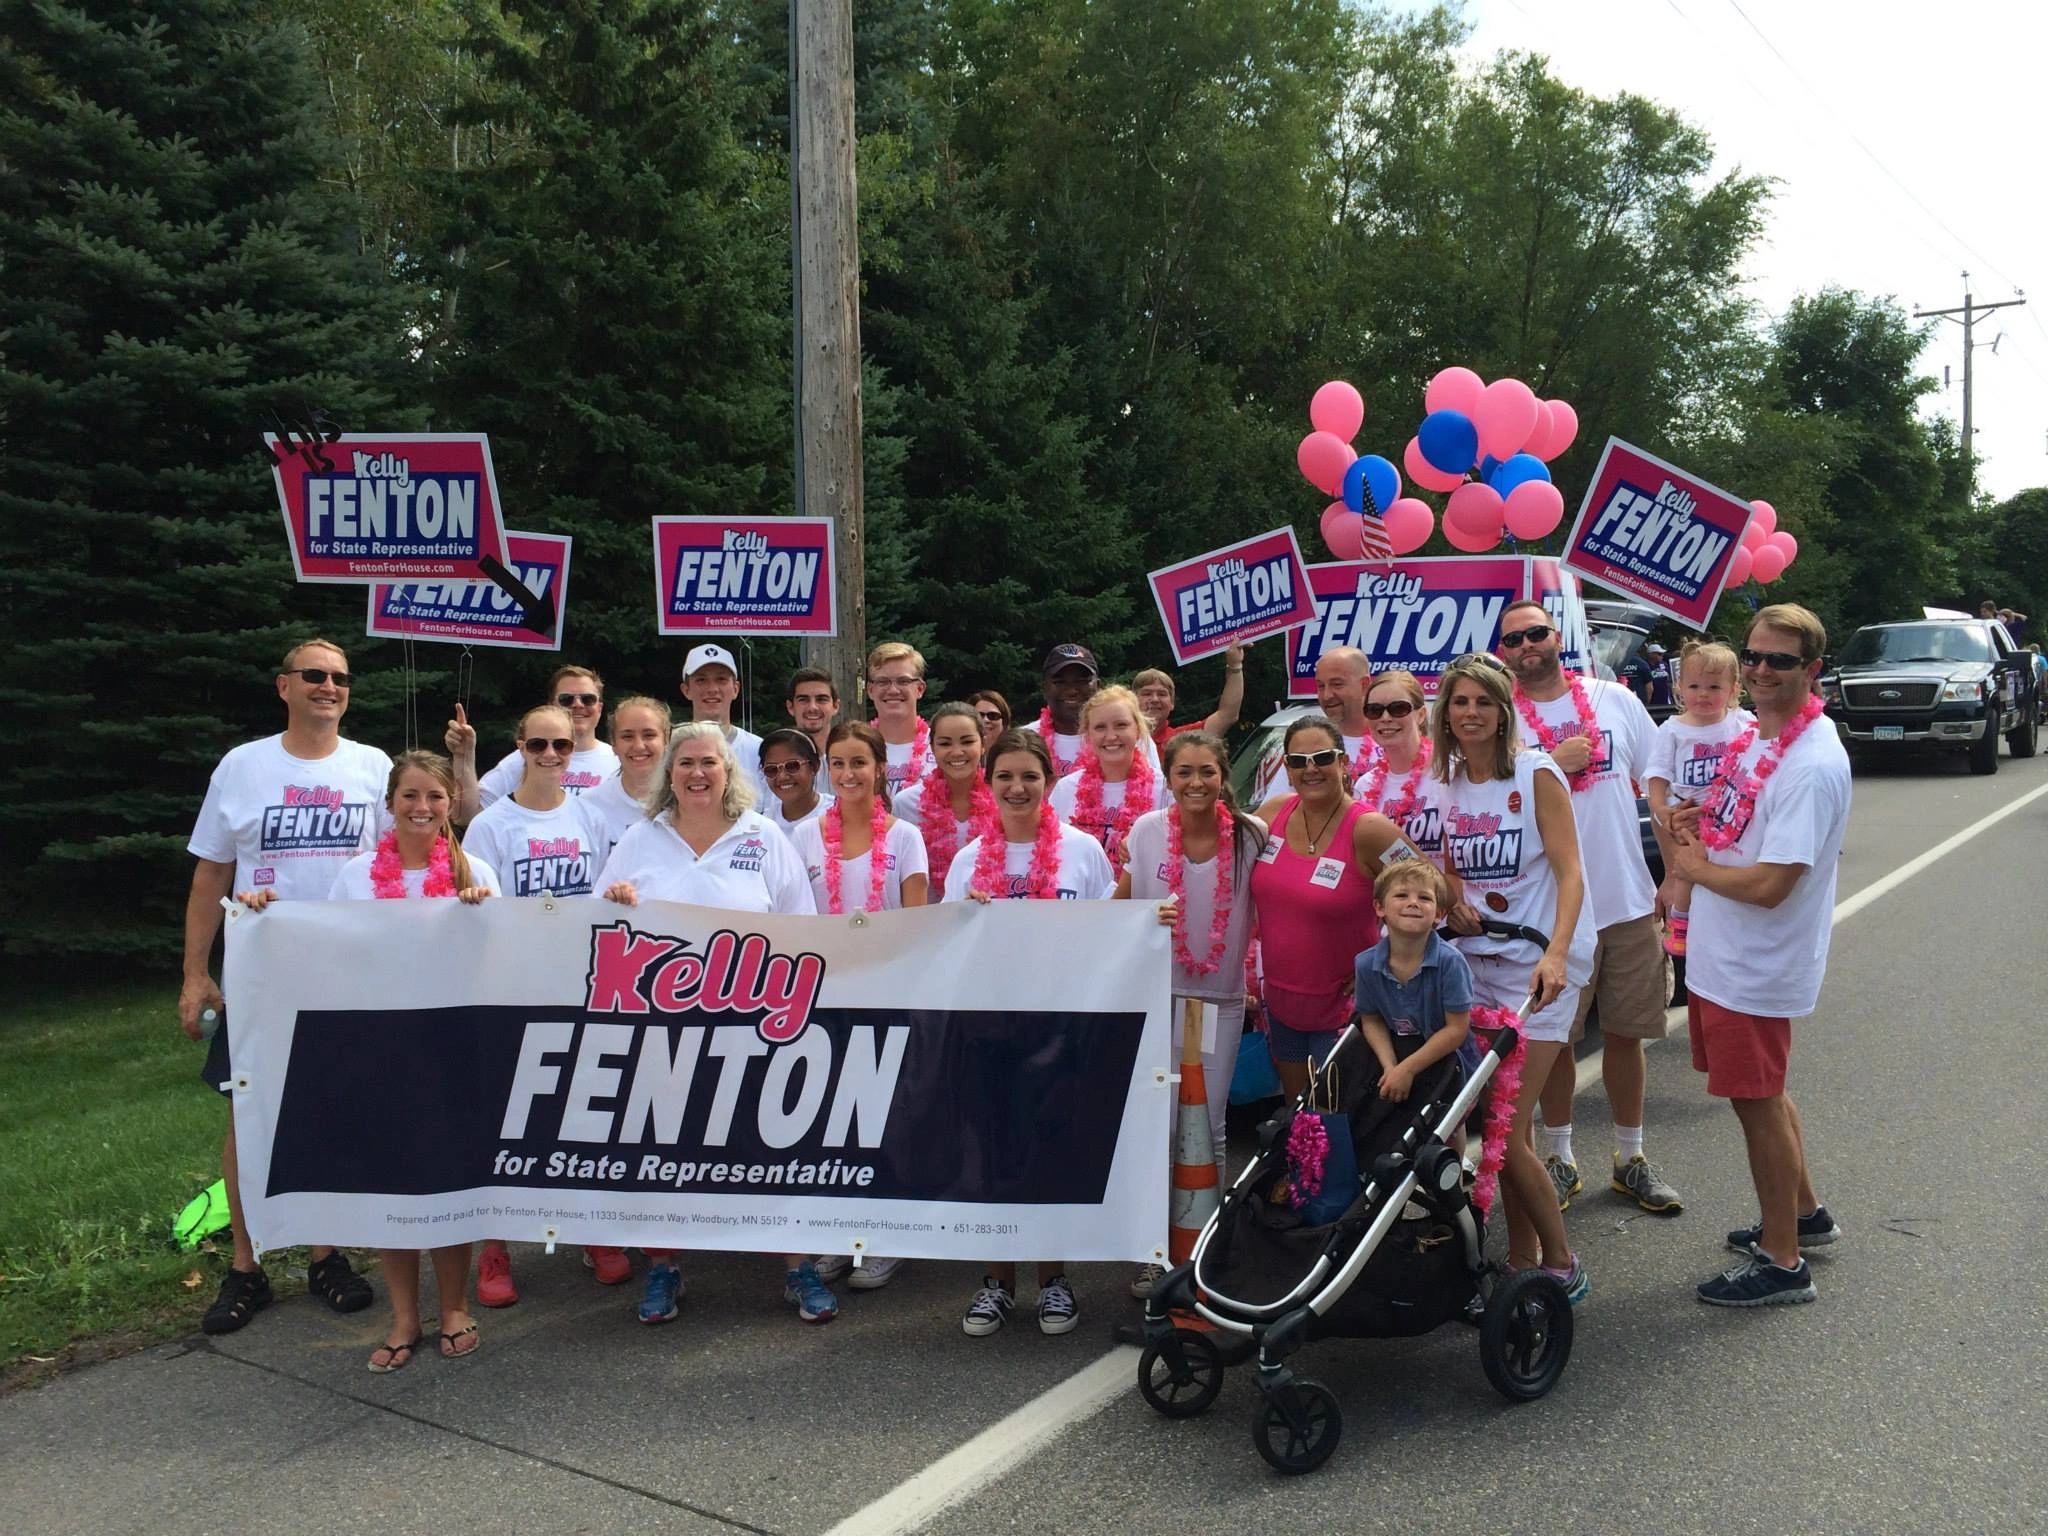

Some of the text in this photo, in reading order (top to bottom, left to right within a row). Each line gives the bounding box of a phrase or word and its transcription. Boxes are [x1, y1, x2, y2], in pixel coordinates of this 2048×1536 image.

[352, 450, 409, 488] Kelly
[308, 479, 475, 539] FENTON
[1654, 479, 1697, 524] Kelly
[310, 541, 473, 557] for State Representative
[723, 529, 768, 559] Kelly
[1592, 486, 1729, 583] FENTON
[349, 561, 455, 574] FentonForHouse.com
[676, 552, 818, 599] FENTON
[1206, 558, 1246, 583] Kelly
[1584, 537, 1697, 596] for State Representative
[1178, 557, 1292, 632] FENTON
[1356, 571, 1424, 605] Kelly
[1604, 566, 1675, 605] FentonForHouse.com
[386, 603, 525, 624] for State Representati
[674, 601, 808, 614] for State Representative
[705, 617, 791, 627] FentonForHouse.com
[1183, 601, 1293, 644] for State Representative
[419, 622, 513, 637] FentonForHouse.com
[1298, 596, 1505, 658] FENTON
[1296, 660, 1311, 673] for
[283, 784, 344, 812] Kelly
[264, 806, 364, 840] FENTON
[275, 840, 297, 849] State
[299, 838, 358, 848] Representative
[528, 837, 580, 861] Kelly
[585, 921, 826, 1046] Kelly
[499, 1022, 911, 1149] FENTON
[493, 1150, 875, 1188] for State Representative
[386, 1214, 430, 1225] Prepared
[432, 1212, 451, 1223] and
[453, 1208, 474, 1222] paid
[476, 1207, 490, 1216] for
[492, 1206, 502, 1217] by
[505, 1206, 536, 1217] Fenton
[538, 1208, 553, 1218] For
[619, 1211, 665, 1222] Sundance
[692, 1214, 739, 1226] Woodbury,
[742, 1215, 758, 1225] MN
[760, 1216, 788, 1226] 55129
[808, 1218, 933, 1232] www.FentonForHouse.com
[953, 1223, 1019, 1235] 651-283-3011
